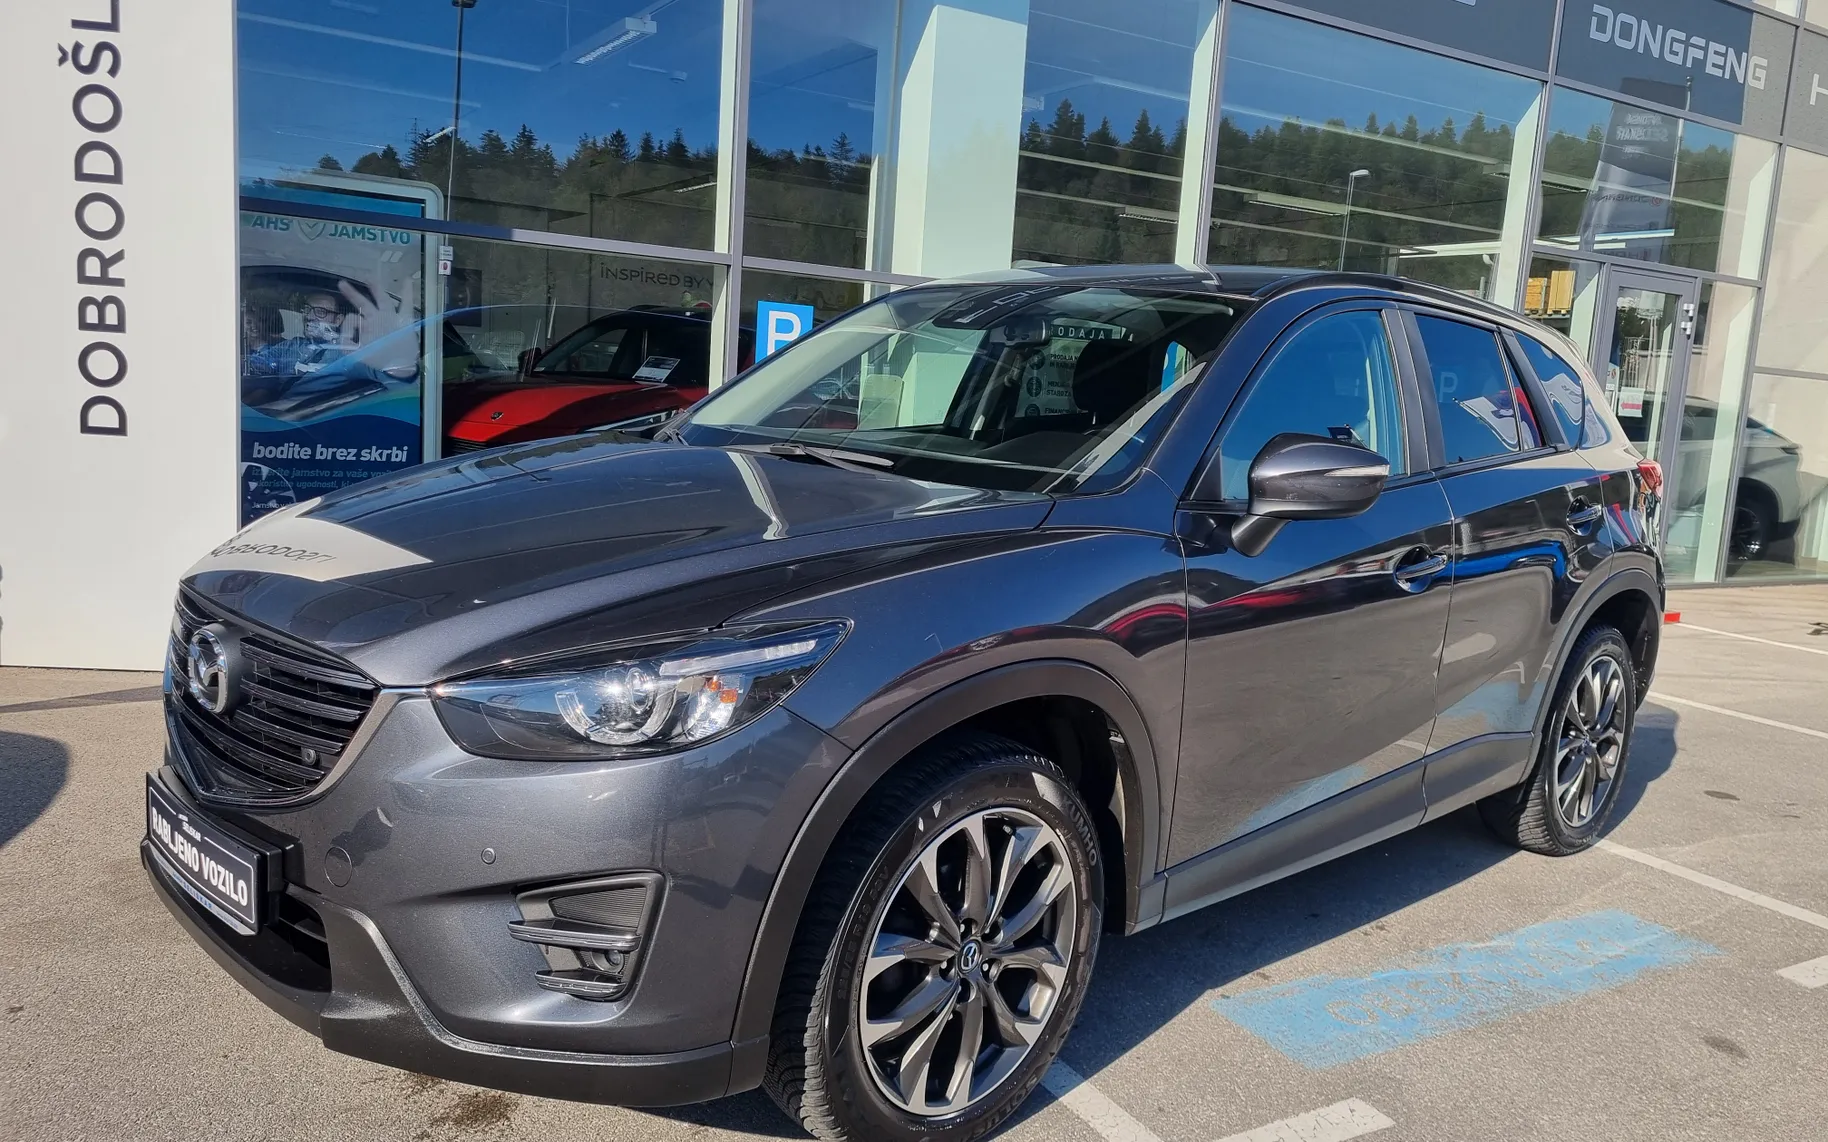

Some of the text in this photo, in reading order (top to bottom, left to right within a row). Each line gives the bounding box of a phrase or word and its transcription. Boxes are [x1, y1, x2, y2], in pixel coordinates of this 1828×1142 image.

[1589, 3, 1768, 90] DONGFENG
[57, 0, 128, 437] DOBRODOŠL
[328, 223, 411, 245] JAMSTVO
[766, 310, 802, 356] P
[252, 442, 409, 463] bodite brez skrbi
[151, 806, 248, 907] RABLJENO VOZILO
